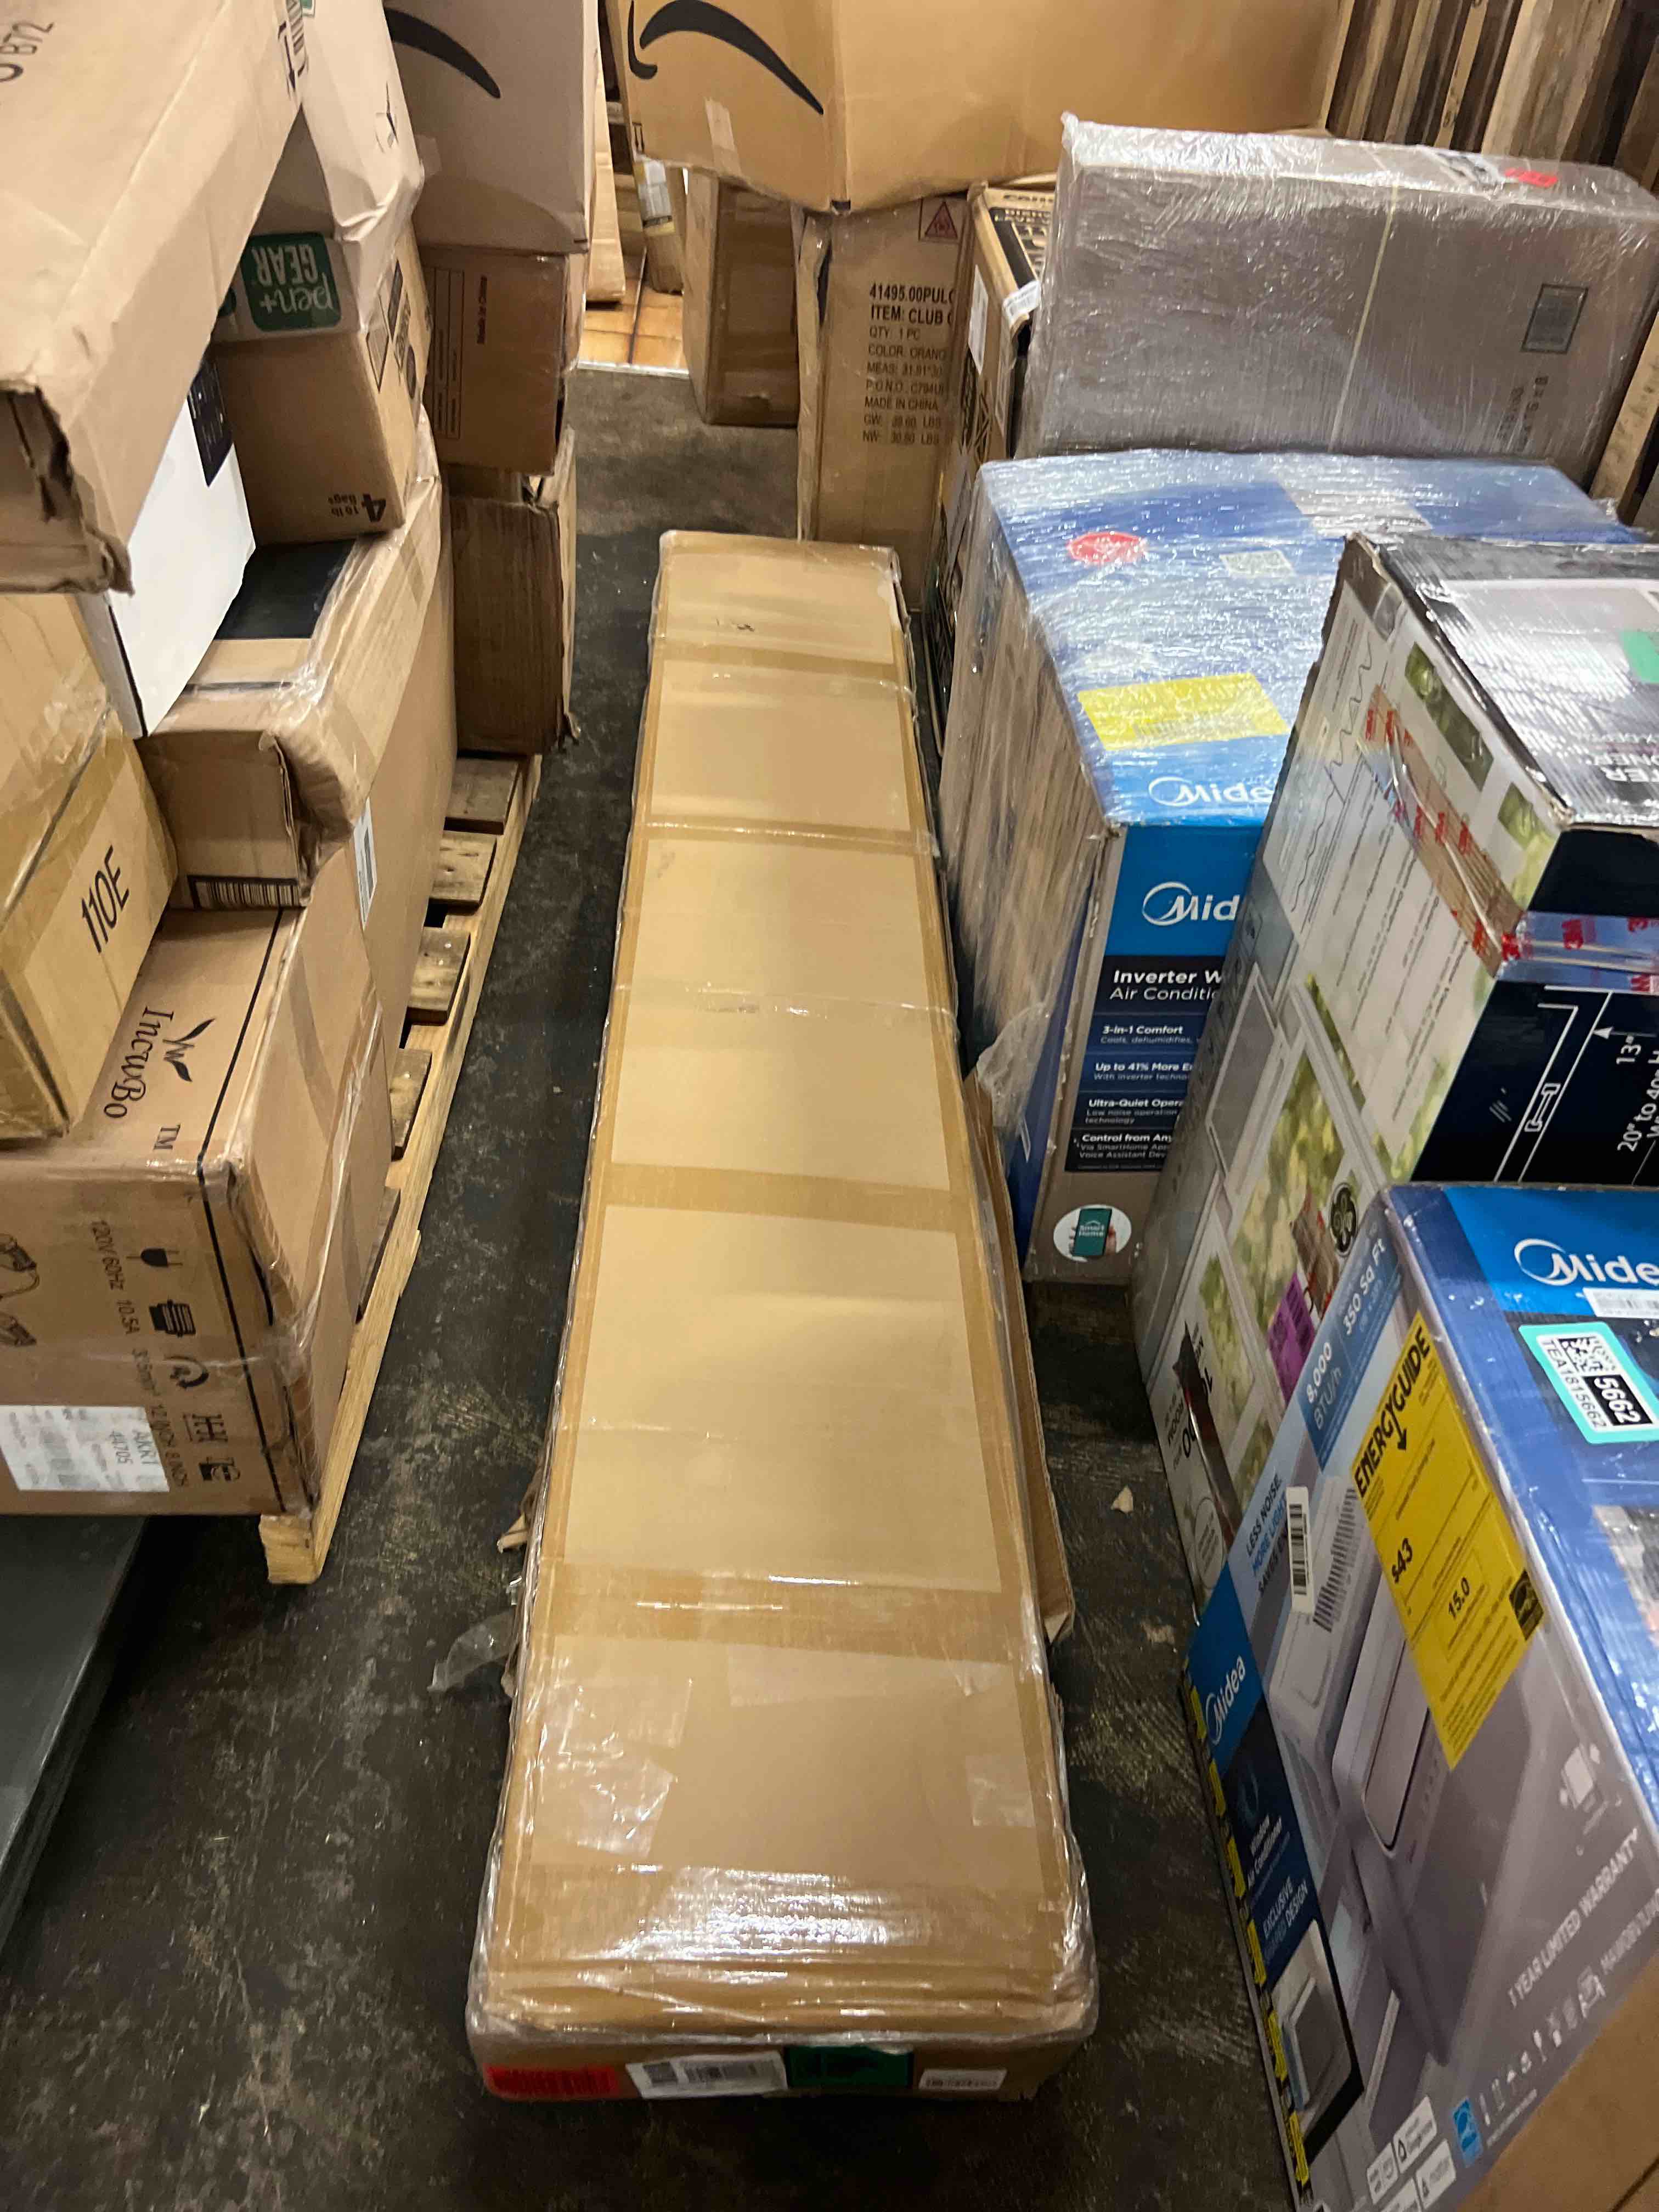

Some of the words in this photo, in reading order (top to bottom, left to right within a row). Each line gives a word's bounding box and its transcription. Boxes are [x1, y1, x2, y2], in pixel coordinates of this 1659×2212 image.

[251, 244, 318, 286] GEAR
[909, 308, 943, 325] CLUB
[865, 396, 892, 409] MADE
[895, 398, 906, 410] IN
[908, 398, 940, 412] CHINA
[361, 494, 386, 522] 4
[82, 844, 129, 955] 110E
[1109, 986, 1138, 1001] Air
[1113, 969, 1198, 984] Inverter
[1102, 1025, 1134, 1035] 3-in-1
[1136, 1025, 1184, 1035] Comfort
[1095, 1062, 1110, 1072] Up
[1114, 1063, 1126, 1071] to
[1152, 1063, 1180, 1071] More
[1088, 1098, 1150, 1108] Ultra-Quiet
[1632, 1102, 1657, 1122] to
[1082, 1133, 1123, 1143] Control
[1124, 1133, 1150, 1143] from
[1306, 1341, 1332, 1404] 8,000
[1343, 1293, 1361, 1335] 350
[1593, 1377, 1641, 1424] 5662
[1246, 1518, 1262, 1557] LESS
[1260, 1473, 1282, 1523] NOISE
[1448, 1577, 1470, 1618] 15.0
[1205, 1655, 1246, 1745] Midea
[1262, 1876, 1294, 1938] EXCLUSIVE
[1284, 1878, 1308, 1927] DESIGN
[1514, 1956, 1543, 2000] YEAR
[1540, 1909, 1582, 1968] LIMITED
[1578, 1827, 1638, 1917] WARRANTY
